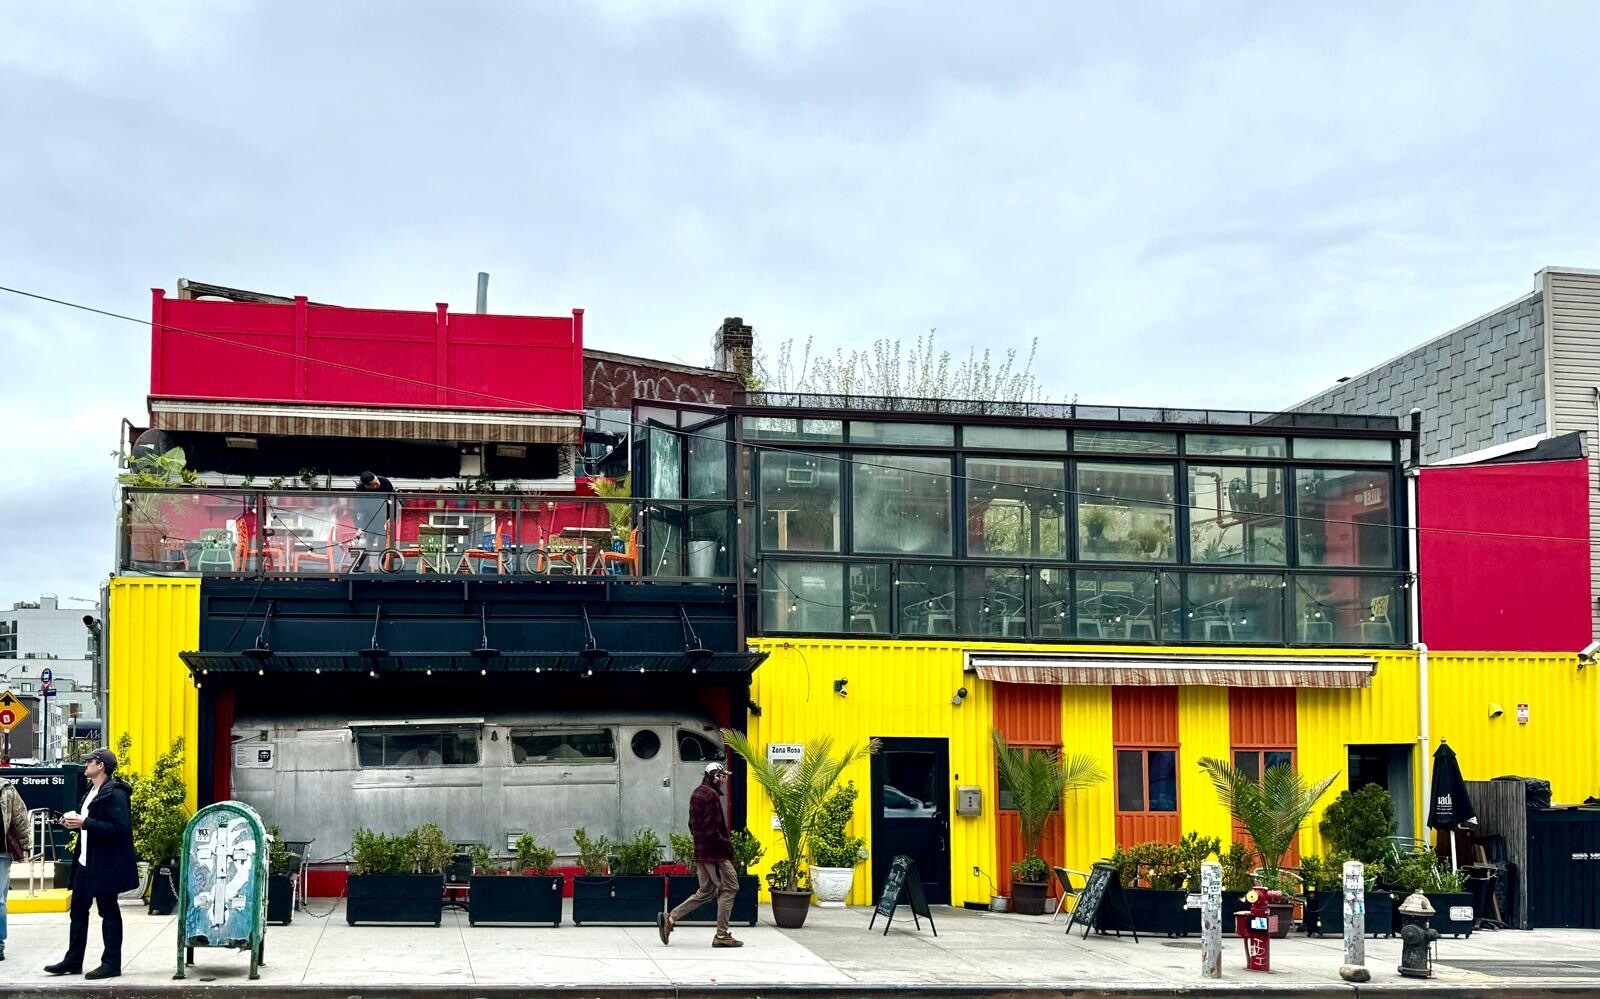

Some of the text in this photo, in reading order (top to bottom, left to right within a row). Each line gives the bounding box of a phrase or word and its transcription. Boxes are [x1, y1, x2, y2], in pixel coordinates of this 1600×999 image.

[349, 547, 610, 576] ZONA ROSA
[771, 746, 800, 754] Zona Rosa
[22, 776, 49, 785] Street
